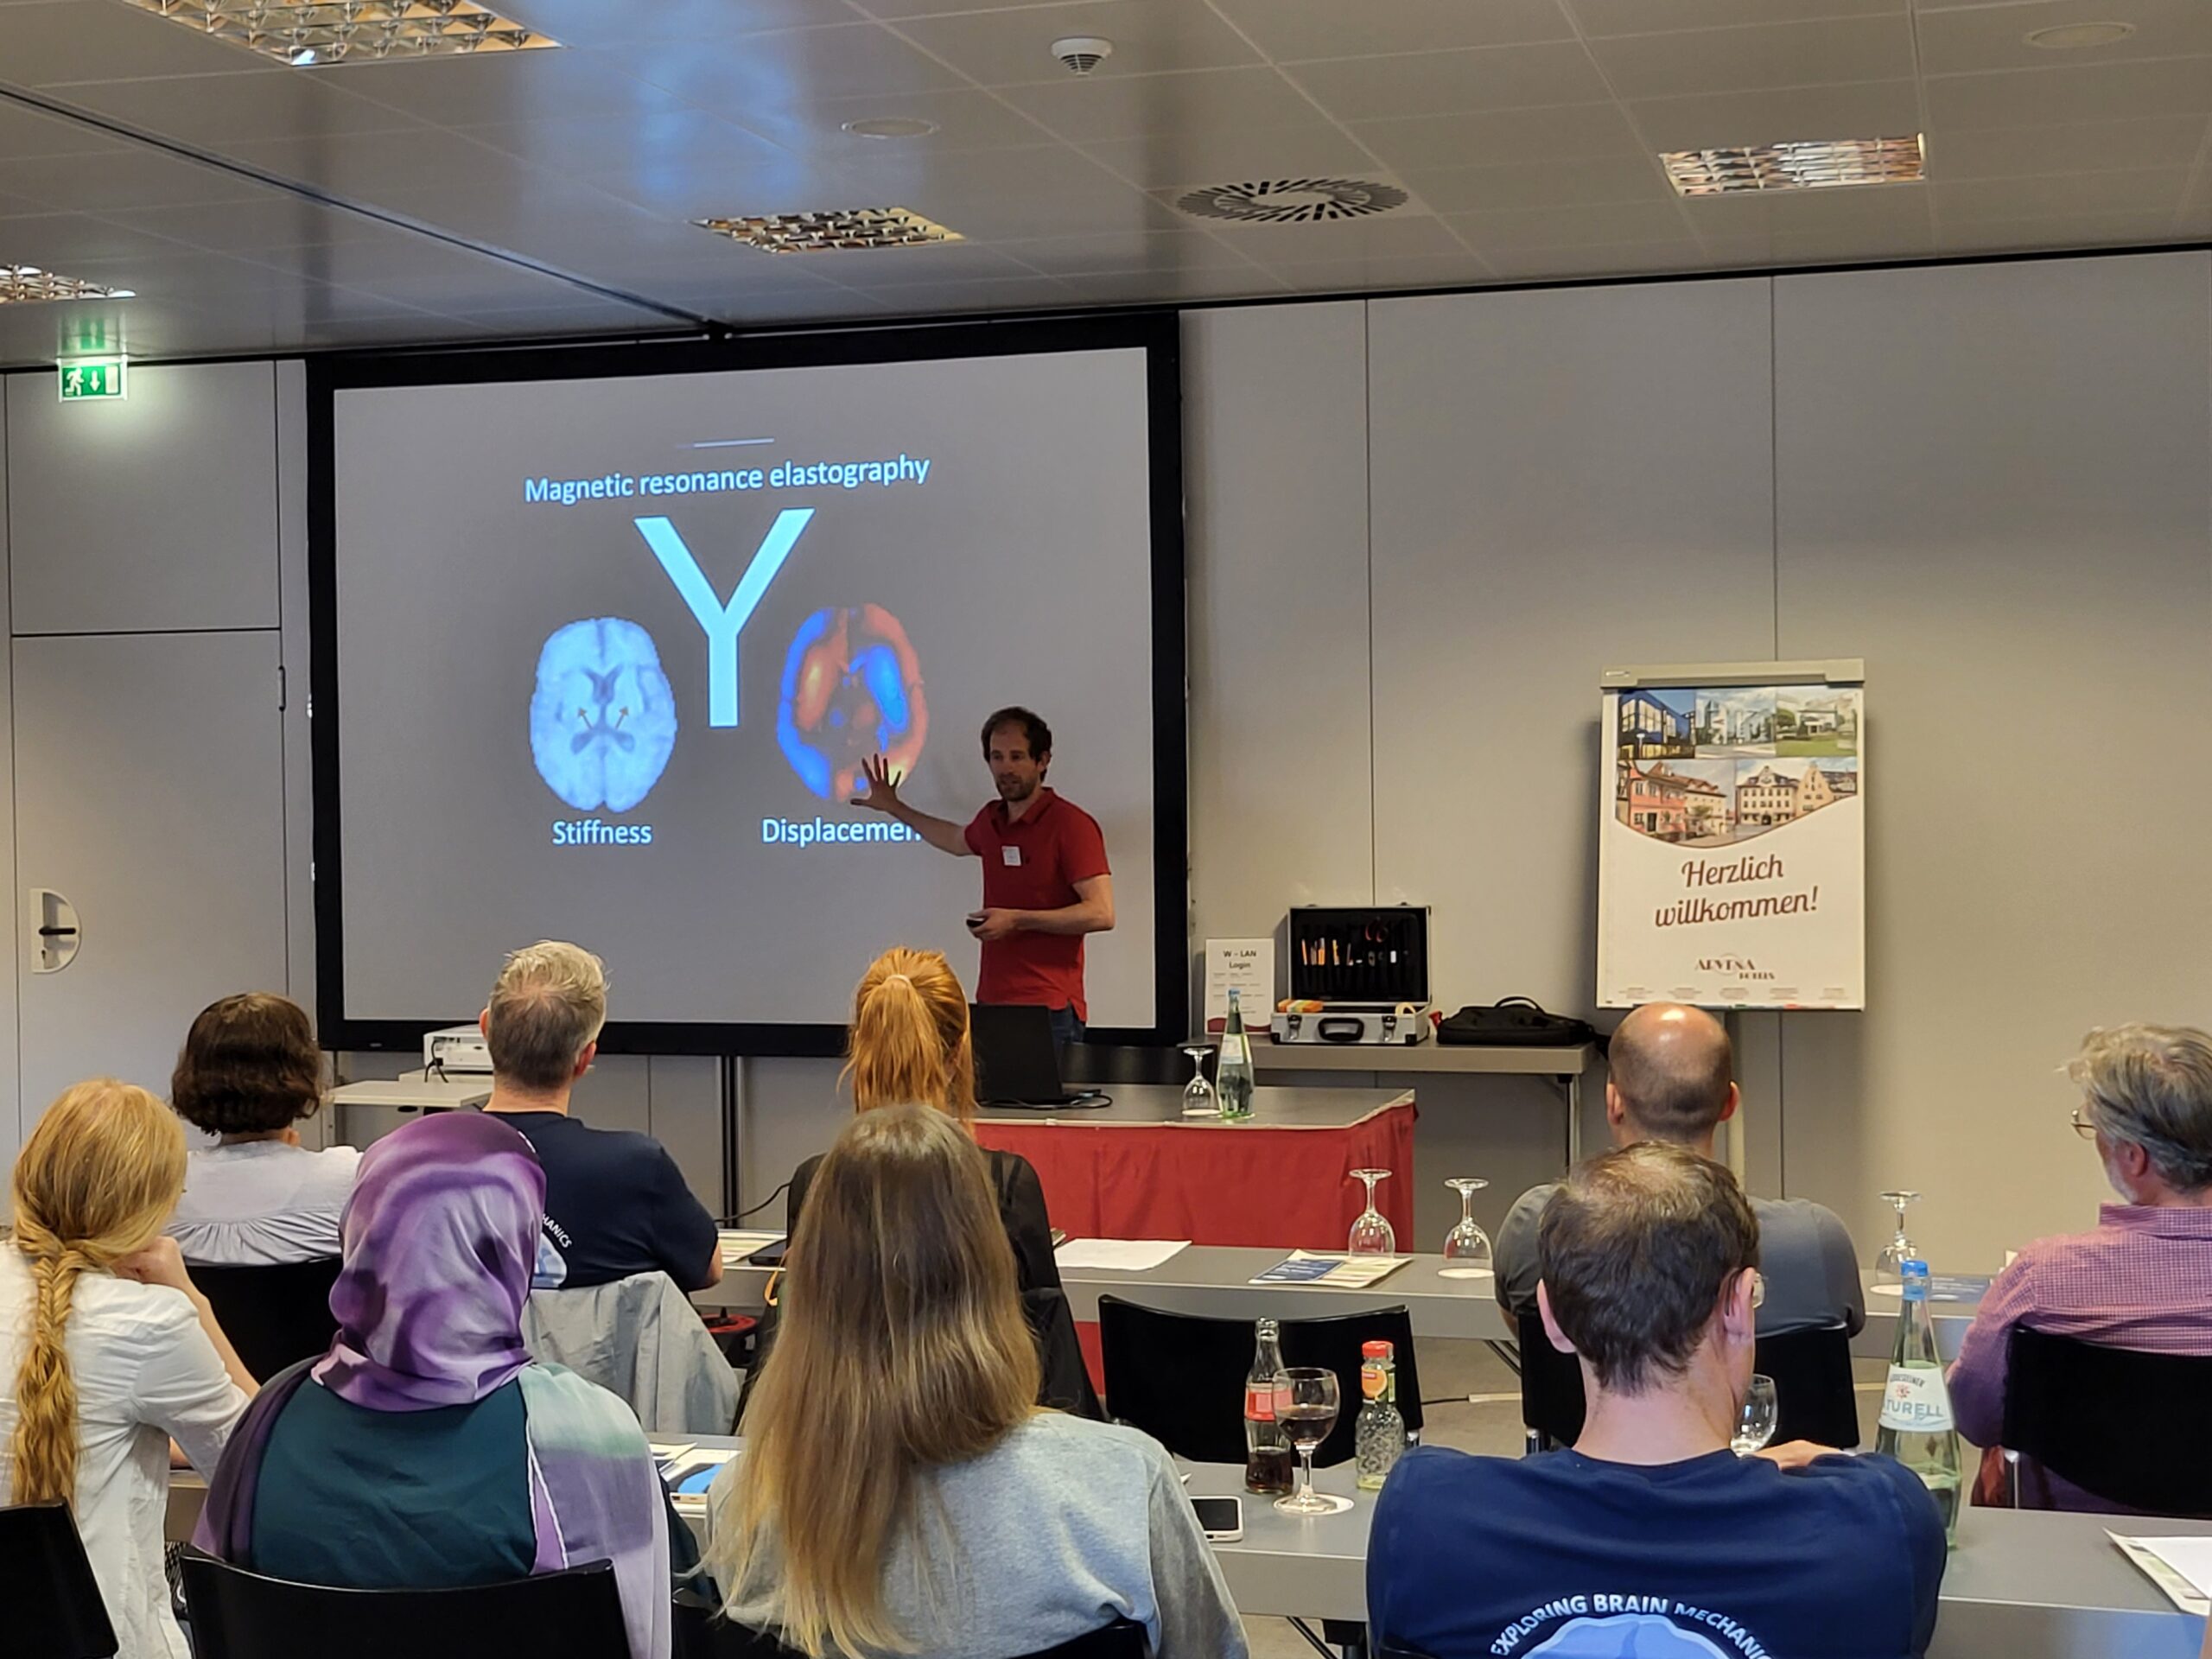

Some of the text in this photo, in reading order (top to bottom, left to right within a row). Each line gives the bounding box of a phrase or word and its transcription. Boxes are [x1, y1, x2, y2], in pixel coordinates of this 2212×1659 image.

[525, 454, 931, 505] Magnetic resonance elastography
[633, 507, 816, 728] Y
[551, 820, 654, 846] Stiffness
[761, 818, 922, 847] Displacemen
[1681, 854, 1783, 887] Herzlich
[1655, 886, 1818, 927] willkommen!
[543, 1213, 572, 1249] HANICS
[1886, 1399, 1943, 1417] TURELL
[1491, 1594, 1588, 1656] EXPLORING
[1592, 1593, 1668, 1613] BRAIN
